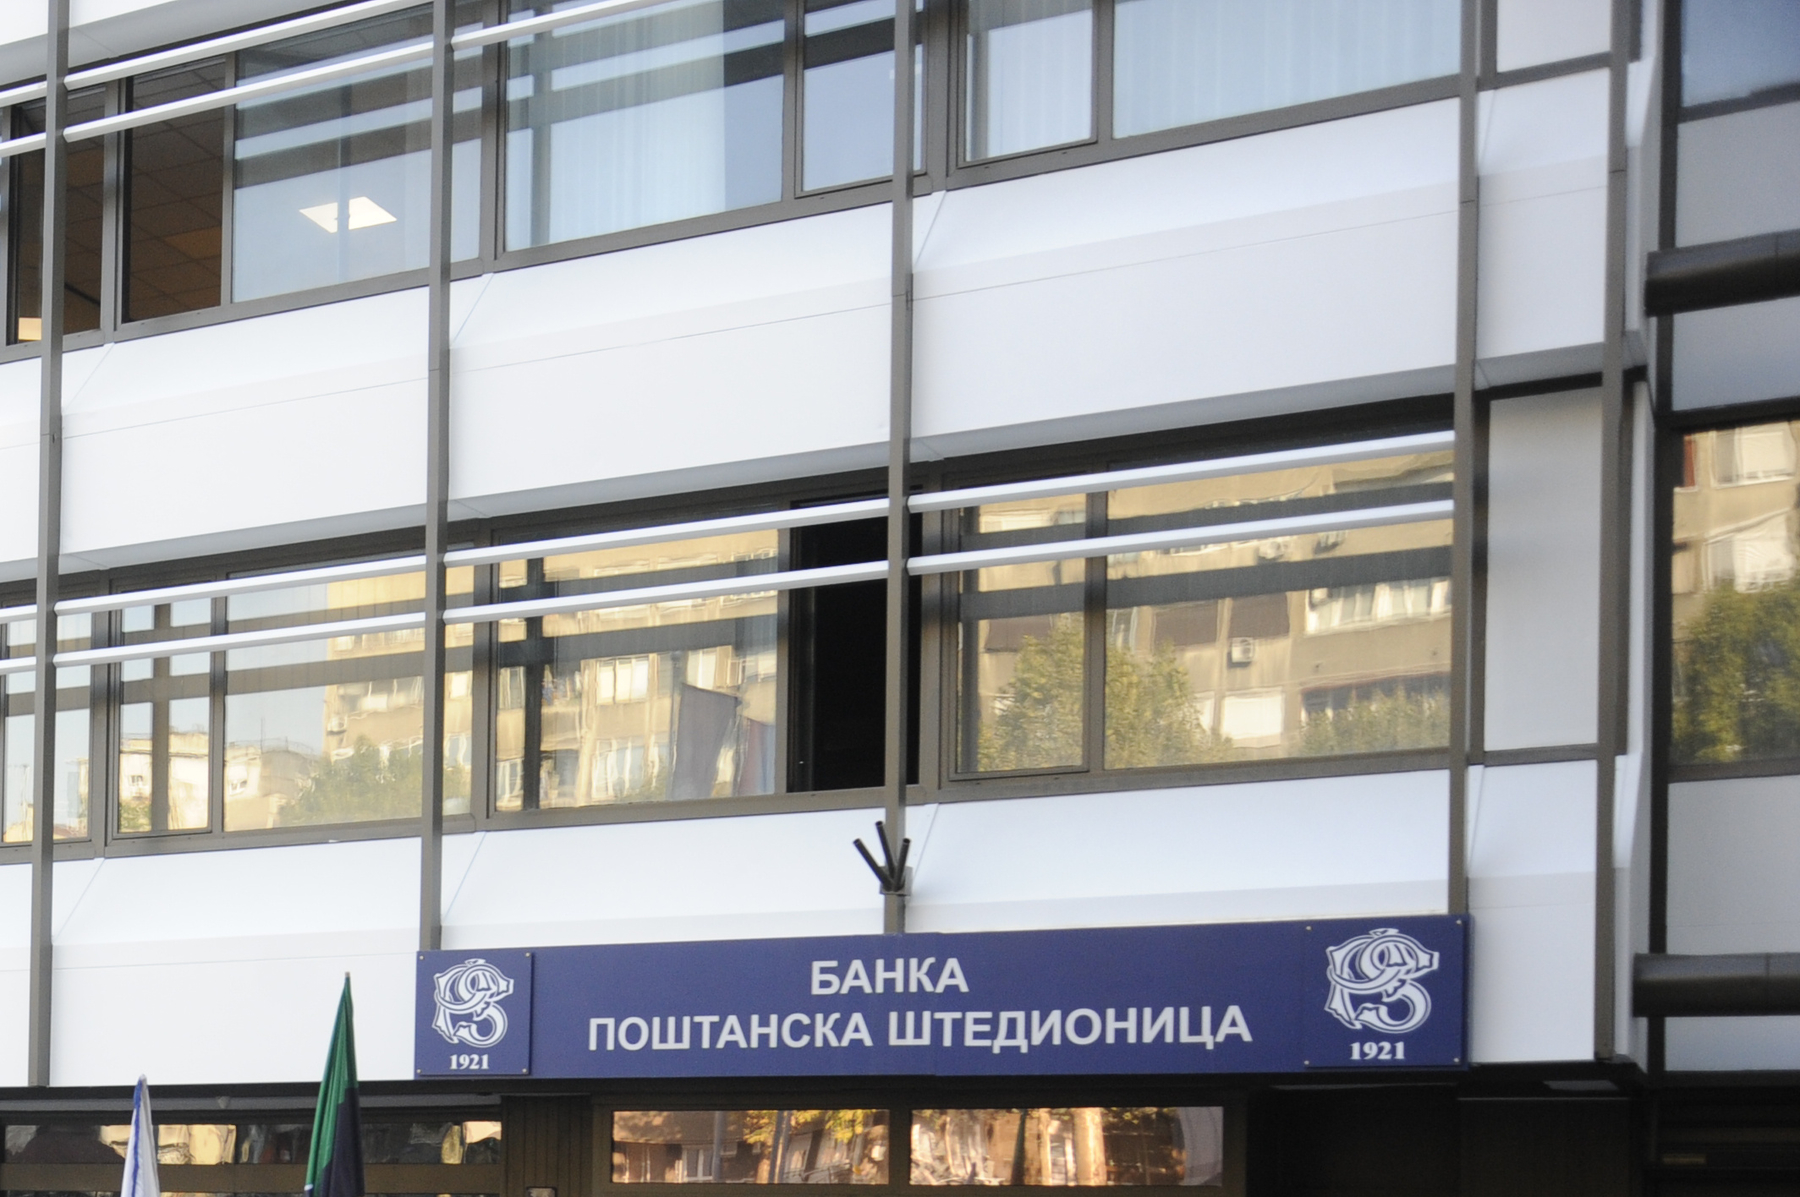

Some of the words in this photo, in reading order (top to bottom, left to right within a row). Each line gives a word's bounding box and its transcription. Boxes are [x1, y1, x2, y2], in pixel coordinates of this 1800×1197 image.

[810, 956, 970, 995] БАНКА
[588, 1012, 874, 1051] ПОШТАНСКА
[887, 1005, 1253, 1054] ШТЕДИОНИЦА
[449, 1053, 489, 1070] 1921
[1350, 1041, 1405, 1060] 1921
